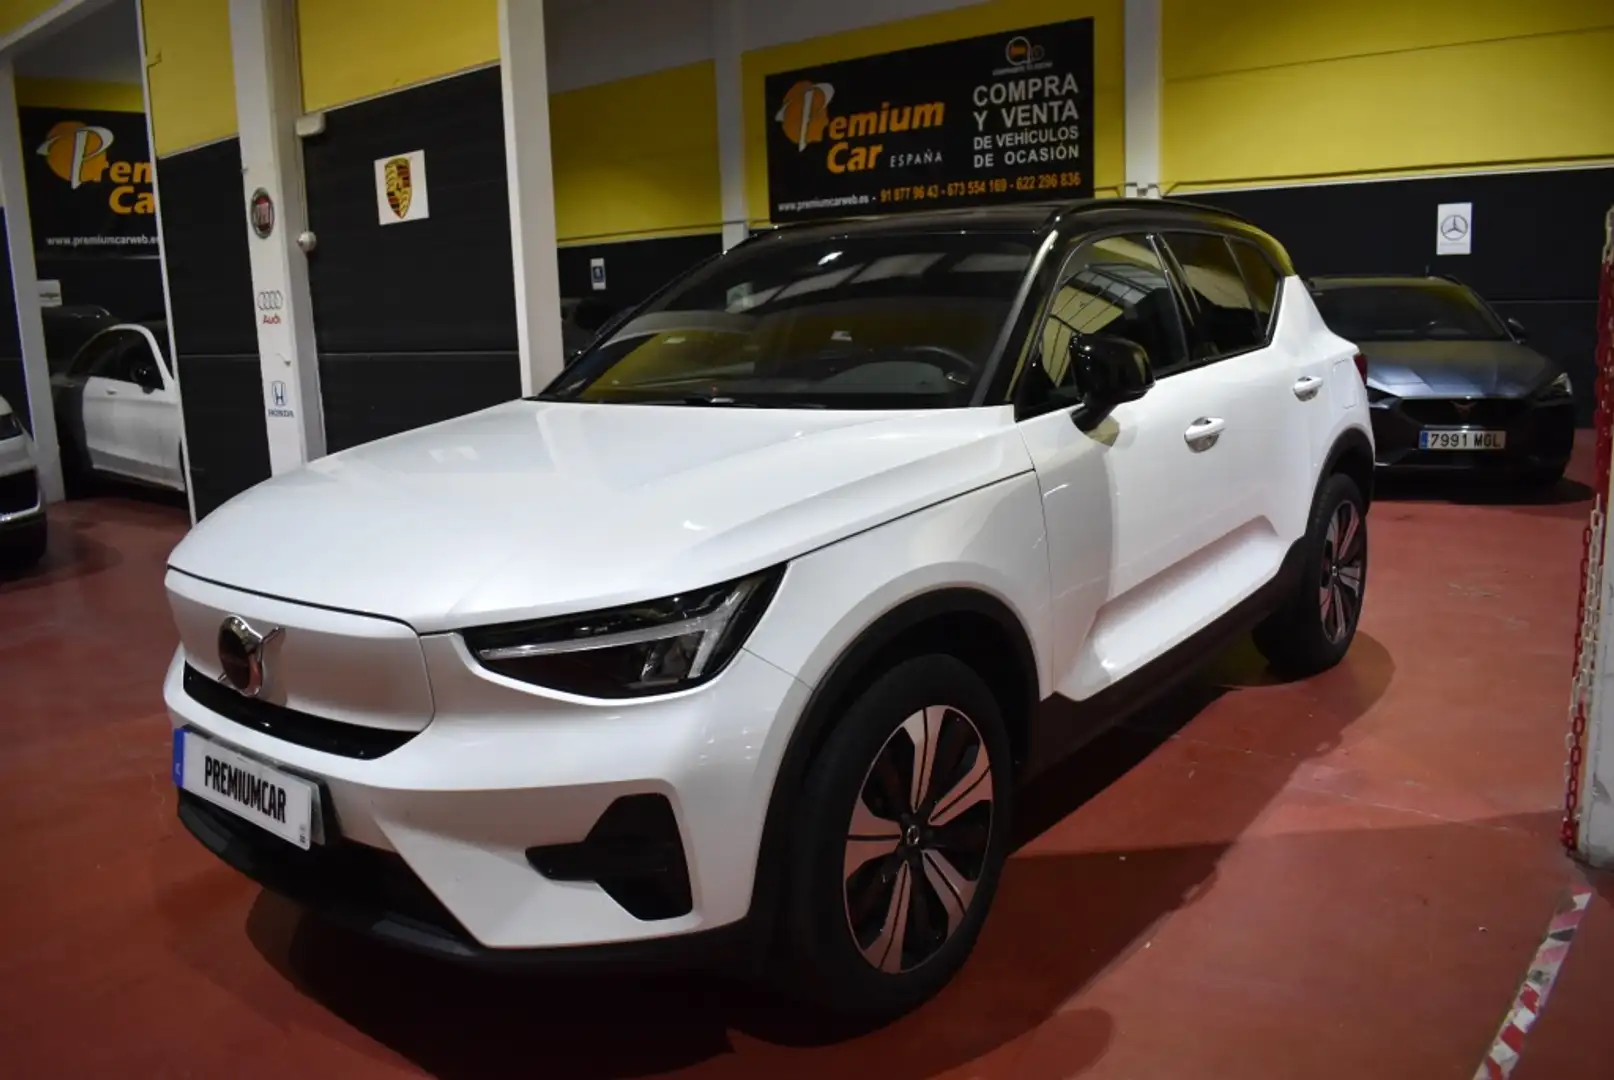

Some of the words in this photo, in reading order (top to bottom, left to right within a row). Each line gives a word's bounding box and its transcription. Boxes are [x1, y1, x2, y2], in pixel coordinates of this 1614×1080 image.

[973, 72, 1079, 107] COMPRA
[775, 82, 946, 152] Premium
[973, 110, 988, 132] Y
[1001, 99, 1080, 128] VENTA
[973, 135, 993, 150] DE
[996, 125, 1079, 147] VEHÍCULOS
[826, 141, 883, 174] Car
[889, 149, 943, 168] ESPAÑA
[973, 153, 994, 168] DE
[1004, 142, 1079, 165] OCASIÓN
[268, 409, 294, 418] HONDA
[1431, 433, 1468, 448] 7991
[1474, 433, 1502, 448] MGL
[204, 754, 287, 824] PREMIUMCAR
